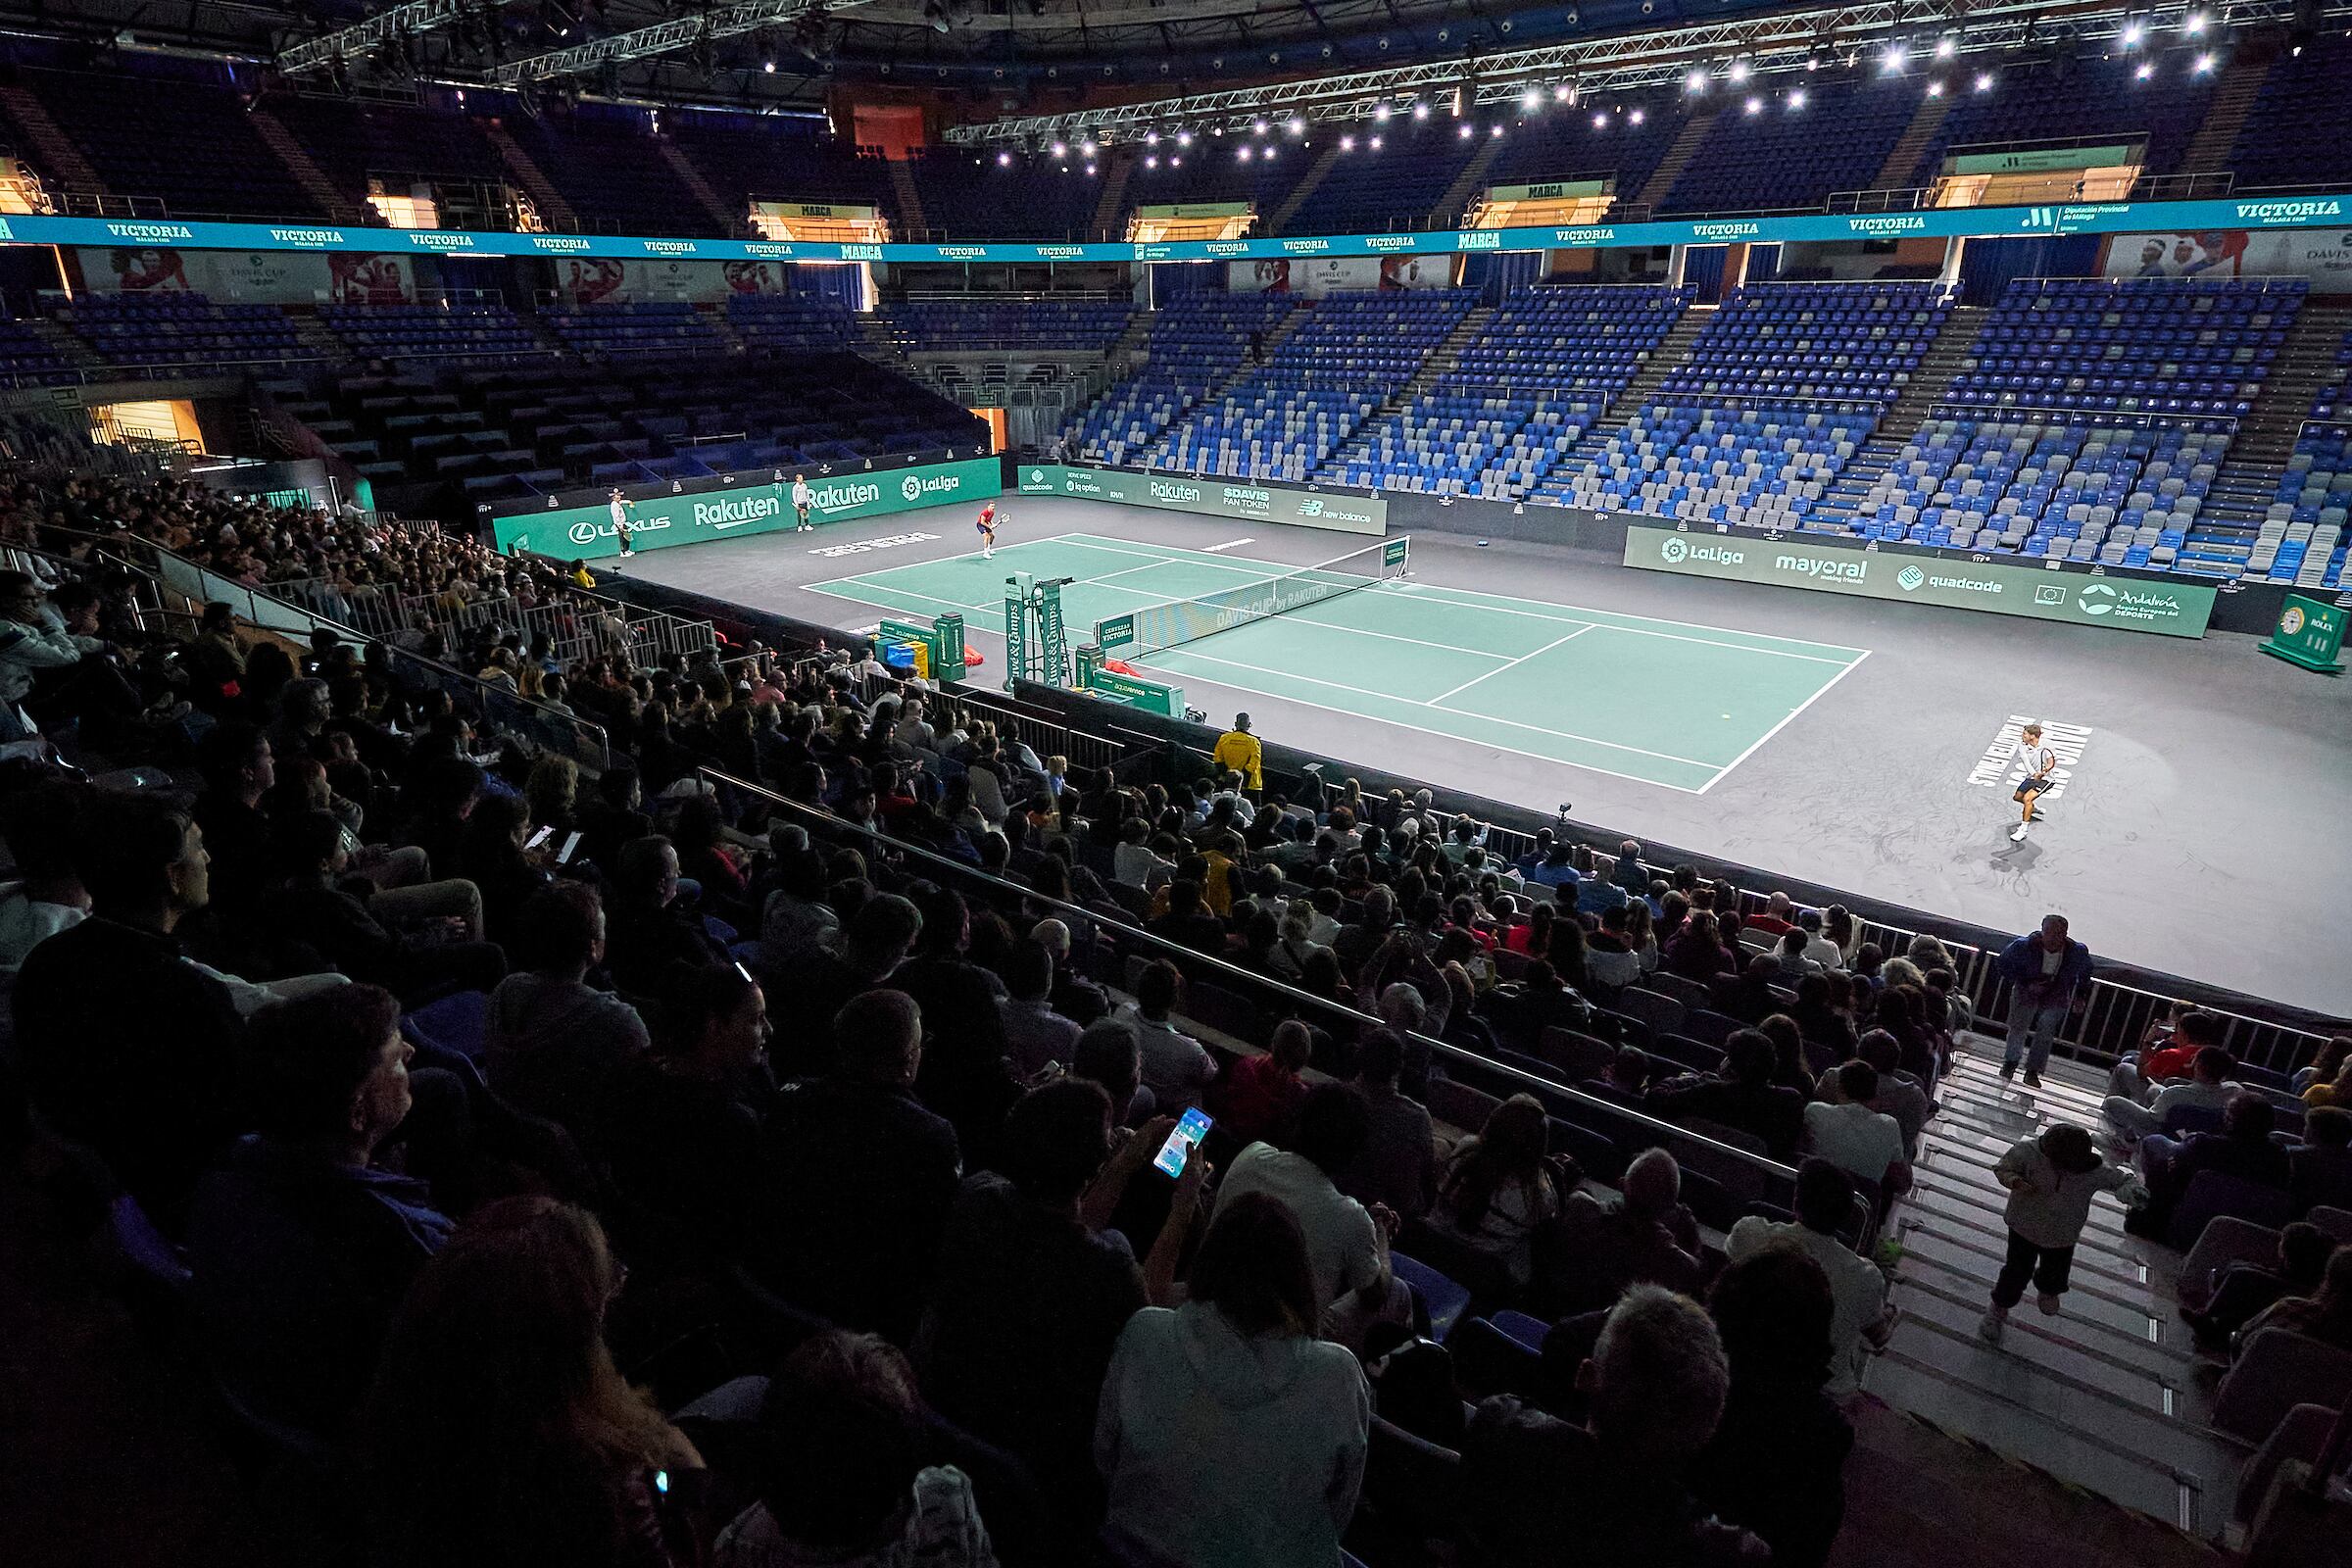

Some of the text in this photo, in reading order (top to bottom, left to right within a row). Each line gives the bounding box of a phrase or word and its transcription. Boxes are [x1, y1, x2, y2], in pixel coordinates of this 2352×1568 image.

[1528, 185, 1563, 198] MARCA
[802, 206, 832, 217] MARCA
[2236, 201, 2341, 218] VICTORIA
[107, 224, 193, 238] VICTORIA
[1692, 222, 1759, 235] VICTORIA
[1849, 218, 1926, 231] VICTORIA
[270, 229, 343, 242] VICTORIA
[410, 234, 474, 246] VICTORIA
[1458, 233, 1500, 249] MARCA
[1555, 229, 1615, 241] VICTORIA
[533, 238, 590, 249] VICTORIA
[644, 241, 696, 252] VICTORIA
[1206, 243, 1250, 253] VICTORIA
[1283, 240, 1329, 250] VICTORIA
[1365, 237, 1415, 247] VICTORIA
[745, 244, 793, 255] VICTORIA
[840, 245, 883, 260] MARCA
[938, 247, 986, 256] VICTORIA
[1037, 247, 1084, 256] VICTORIA
[2307, 249, 2350, 260] DAVIS
[922, 475, 959, 492] LaLiga
[808, 483, 880, 510] Rakuten
[1151, 481, 1200, 502] Rakuten
[1223, 487, 1270, 501] $DAVIS
[693, 496, 780, 526] Rakuten
[1241, 499, 1270, 510] TOKEN
[1340, 512, 1371, 523] balance
[1690, 545, 1744, 565] LaLiga
[1776, 555, 1868, 578] mayoral
[1820, 574, 1864, 584] making friends
[1929, 576, 2003, 593] quadcode
[1251, 597, 1274, 613] CUP
[1287, 584, 1327, 607] RAKUTEN
[2119, 590, 2180, 610] Andalucía
[2115, 610, 2154, 619] DEPORTE
[2311, 618, 2332, 632] ROLEX
[1102, 629, 1132, 642] VICTORIA
[1966, 757, 2009, 788] FINALS
